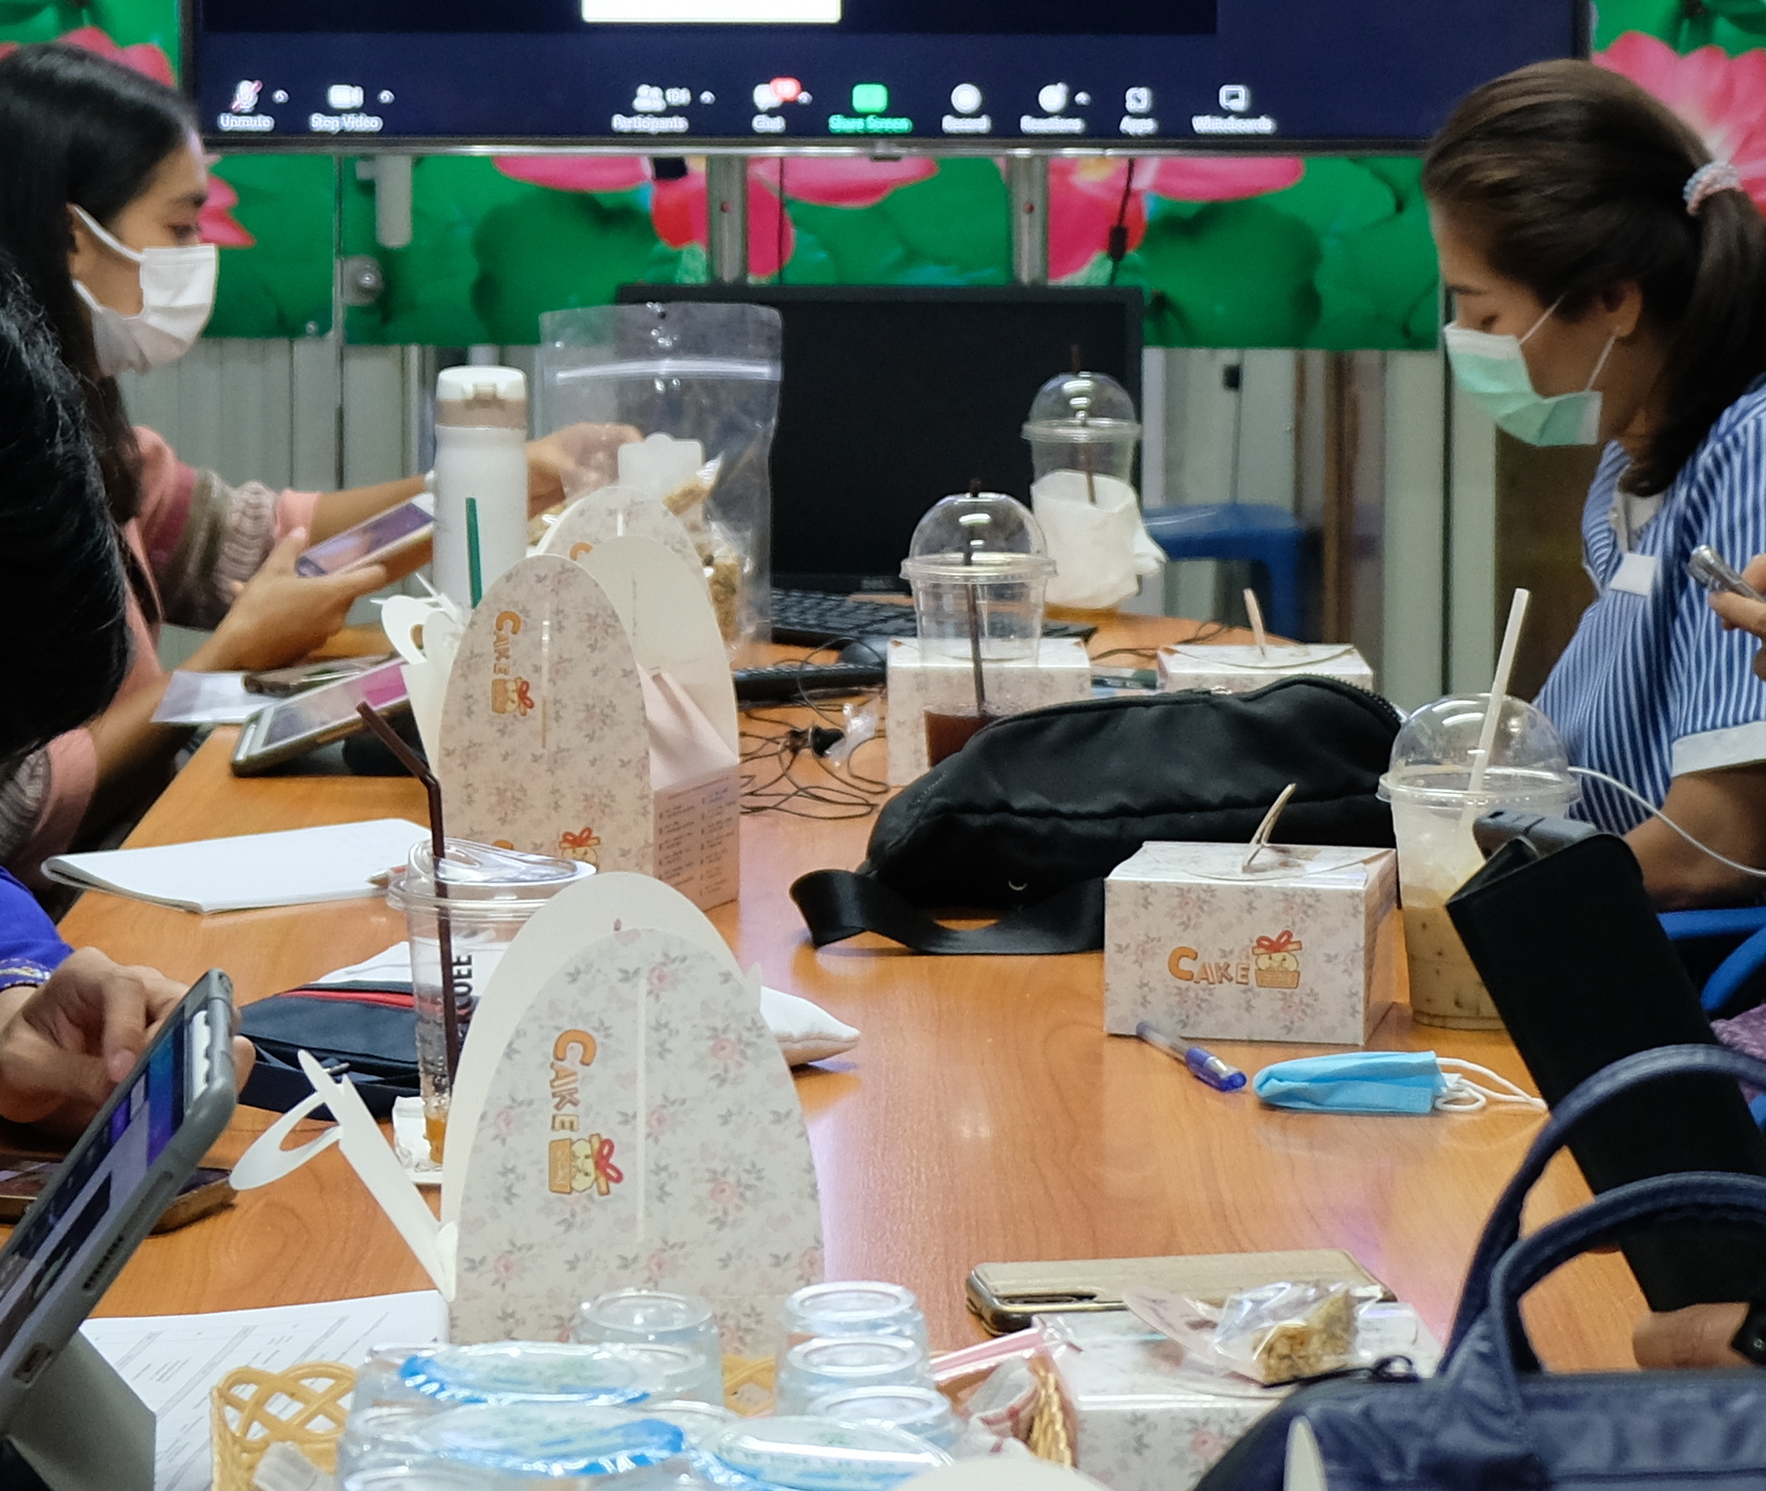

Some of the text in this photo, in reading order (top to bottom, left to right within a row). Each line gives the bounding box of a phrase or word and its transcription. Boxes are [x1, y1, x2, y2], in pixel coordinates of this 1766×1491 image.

[612, 114, 689, 133] Participants
[492, 610, 522, 676] CAKE
[1167, 946, 1251, 986] CAKE
[548, 1027, 597, 1132] CAKE
